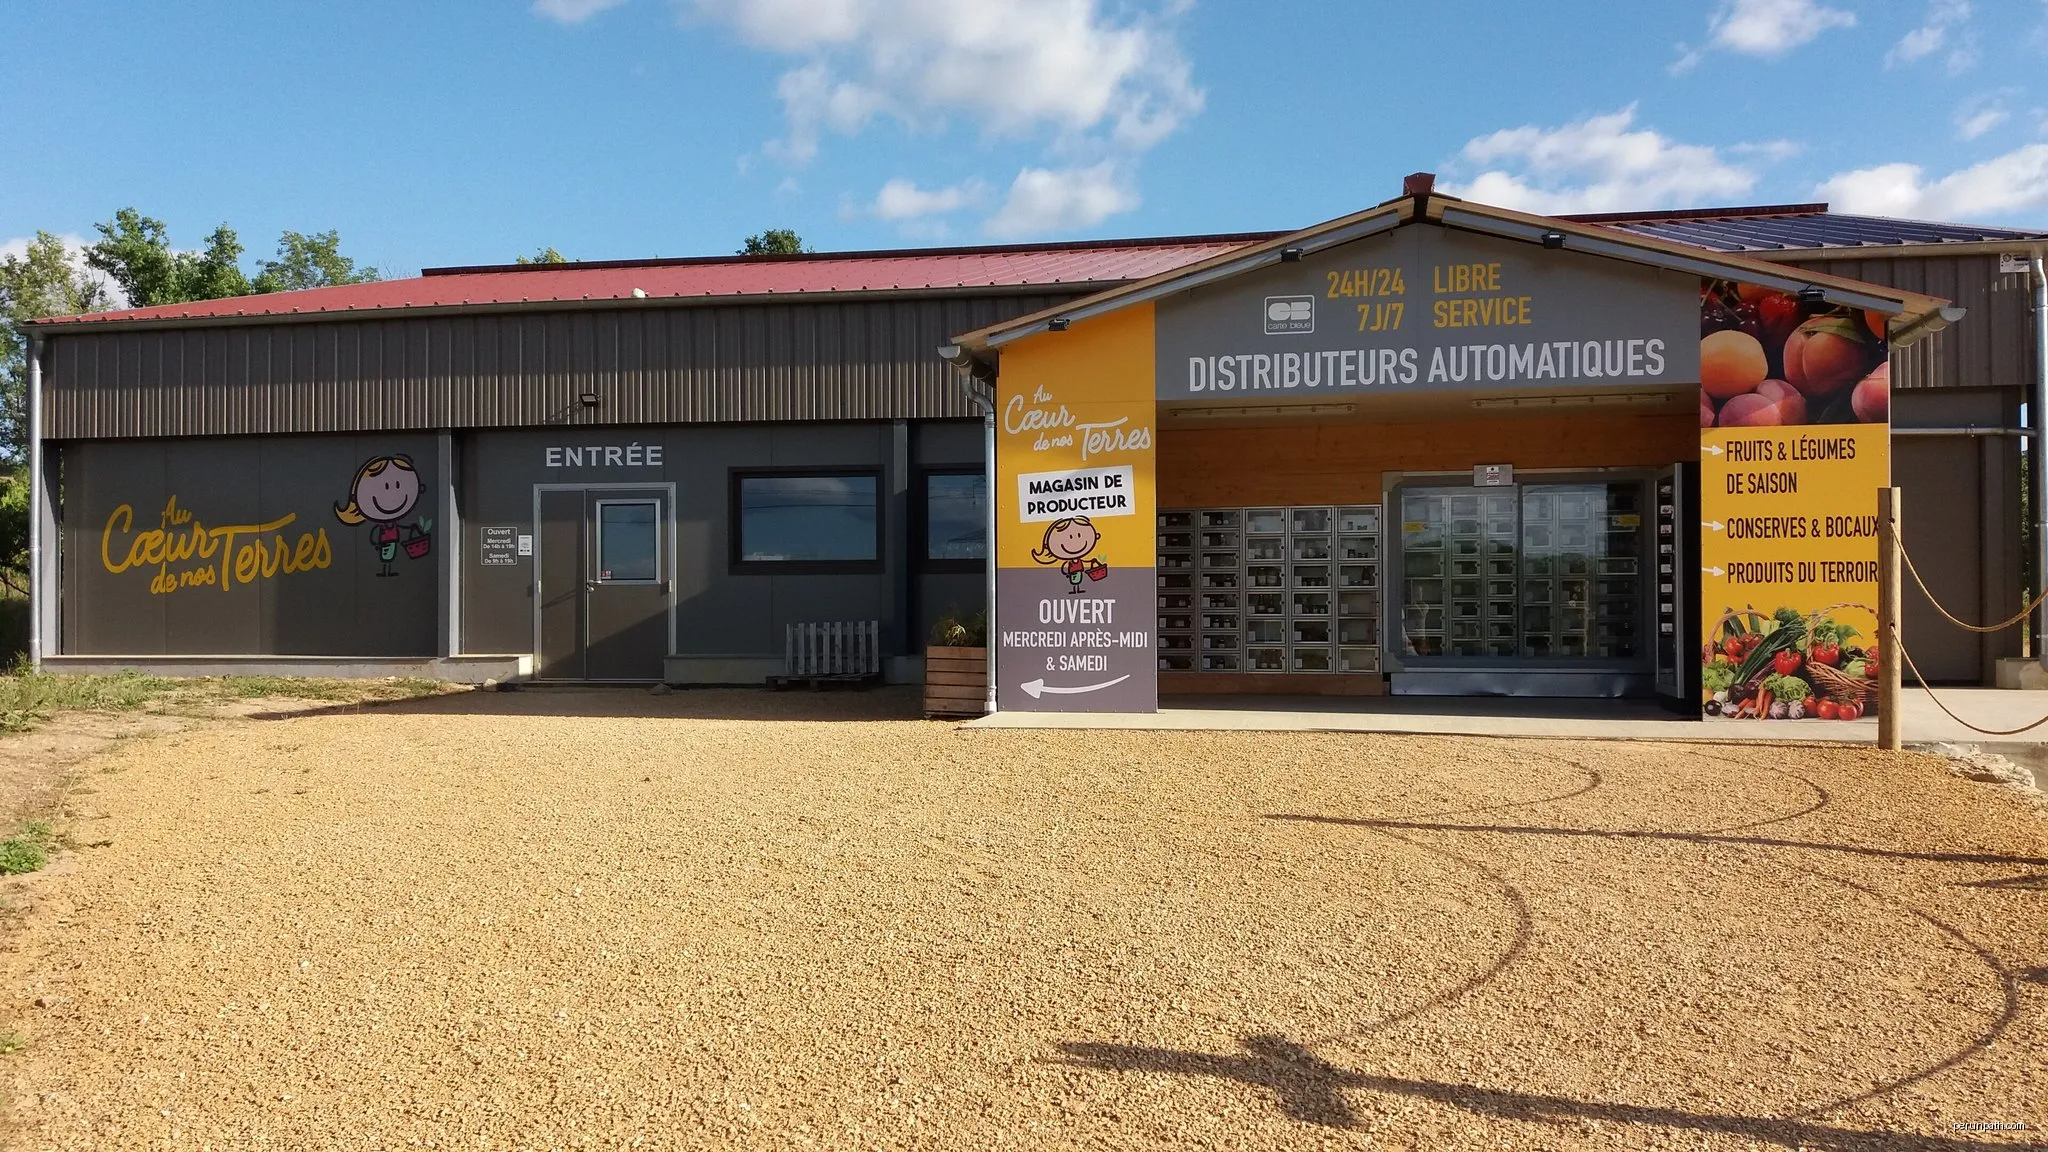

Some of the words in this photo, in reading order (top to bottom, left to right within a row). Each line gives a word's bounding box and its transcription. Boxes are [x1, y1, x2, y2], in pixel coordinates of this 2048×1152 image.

[1327, 267, 1406, 298] 24H/24
[1434, 262, 1501, 293] LIBRE
[1357, 303, 1405, 332] 7J/7
[1433, 296, 1532, 328] SERVICE
[1189, 347, 1419, 392] DISTRIBUTEURS
[1427, 338, 1666, 383] AUTOMATIQUES
[1033, 383, 1052, 404] Au
[1033, 431, 1049, 451] de
[1051, 434, 1073, 447] nos
[1075, 416, 1151, 461] Terres
[1726, 440, 1773, 462] FRUITS
[1777, 441, 1787, 461] &
[1791, 434, 1856, 461] LÉGUMES
[545, 441, 664, 467] ENTRÉE
[1029, 476, 1099, 495] MAGASIN
[1104, 474, 1123, 489] DE
[1726, 473, 1744, 494] DE
[1747, 472, 1798, 494] SAISON
[161, 494, 193, 529] Au
[1027, 494, 1127, 515] PRODUCTEUR
[1727, 517, 1807, 539] CONSERVES
[1811, 518, 1821, 538] &
[1825, 515, 1879, 537] BOCAUX
[150, 561, 178, 594] de
[180, 564, 216, 588] nos
[209, 512, 332, 592] Terres
[1727, 562, 1794, 583] PRODUITS
[1798, 562, 1816, 583] DU
[1039, 599, 1116, 624] OUVERT
[1003, 631, 1067, 648] MERCREDI
[1070, 628, 1148, 648] APRÈS-MIDI
[1046, 656, 1055, 671] &
[1059, 655, 1107, 671] SAMEDI
